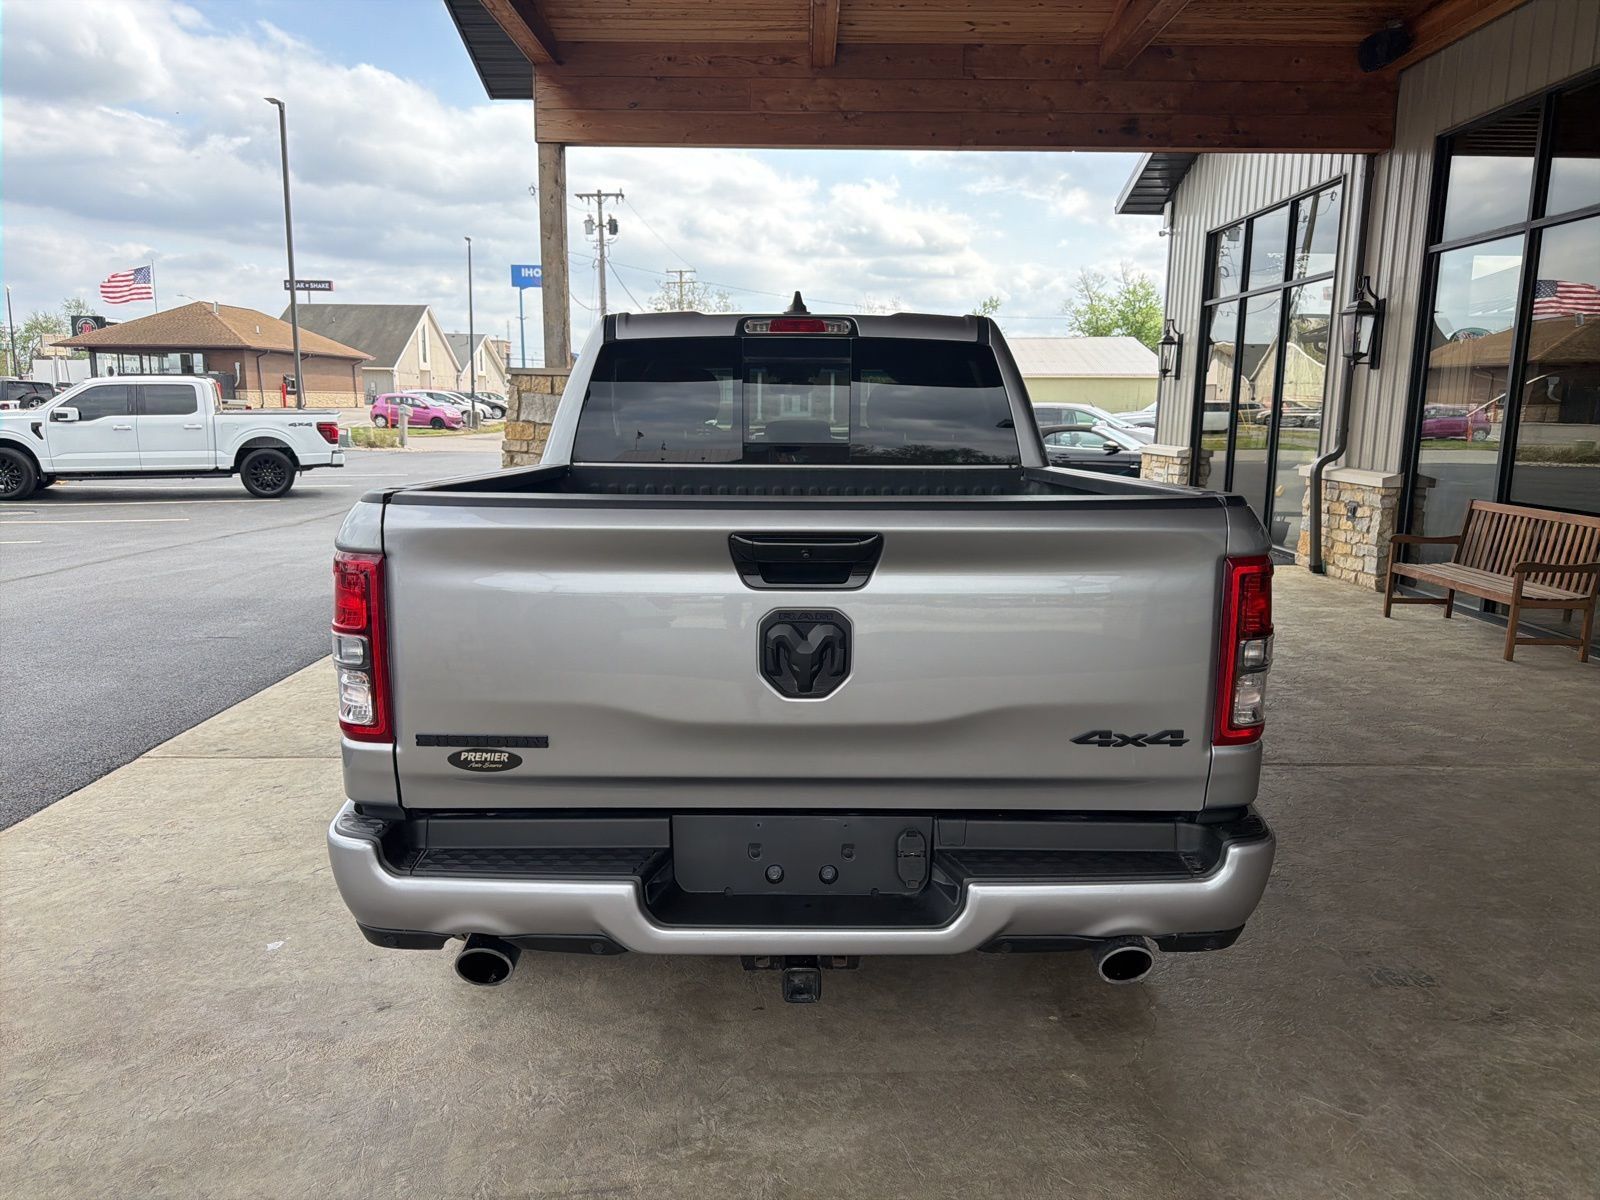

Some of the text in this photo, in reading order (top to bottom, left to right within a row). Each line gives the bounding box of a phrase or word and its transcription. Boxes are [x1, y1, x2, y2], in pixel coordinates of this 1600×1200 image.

[521, 267, 542, 278] IHO
[778, 612, 833, 621] RAM
[460, 752, 509, 762] PREMIER
